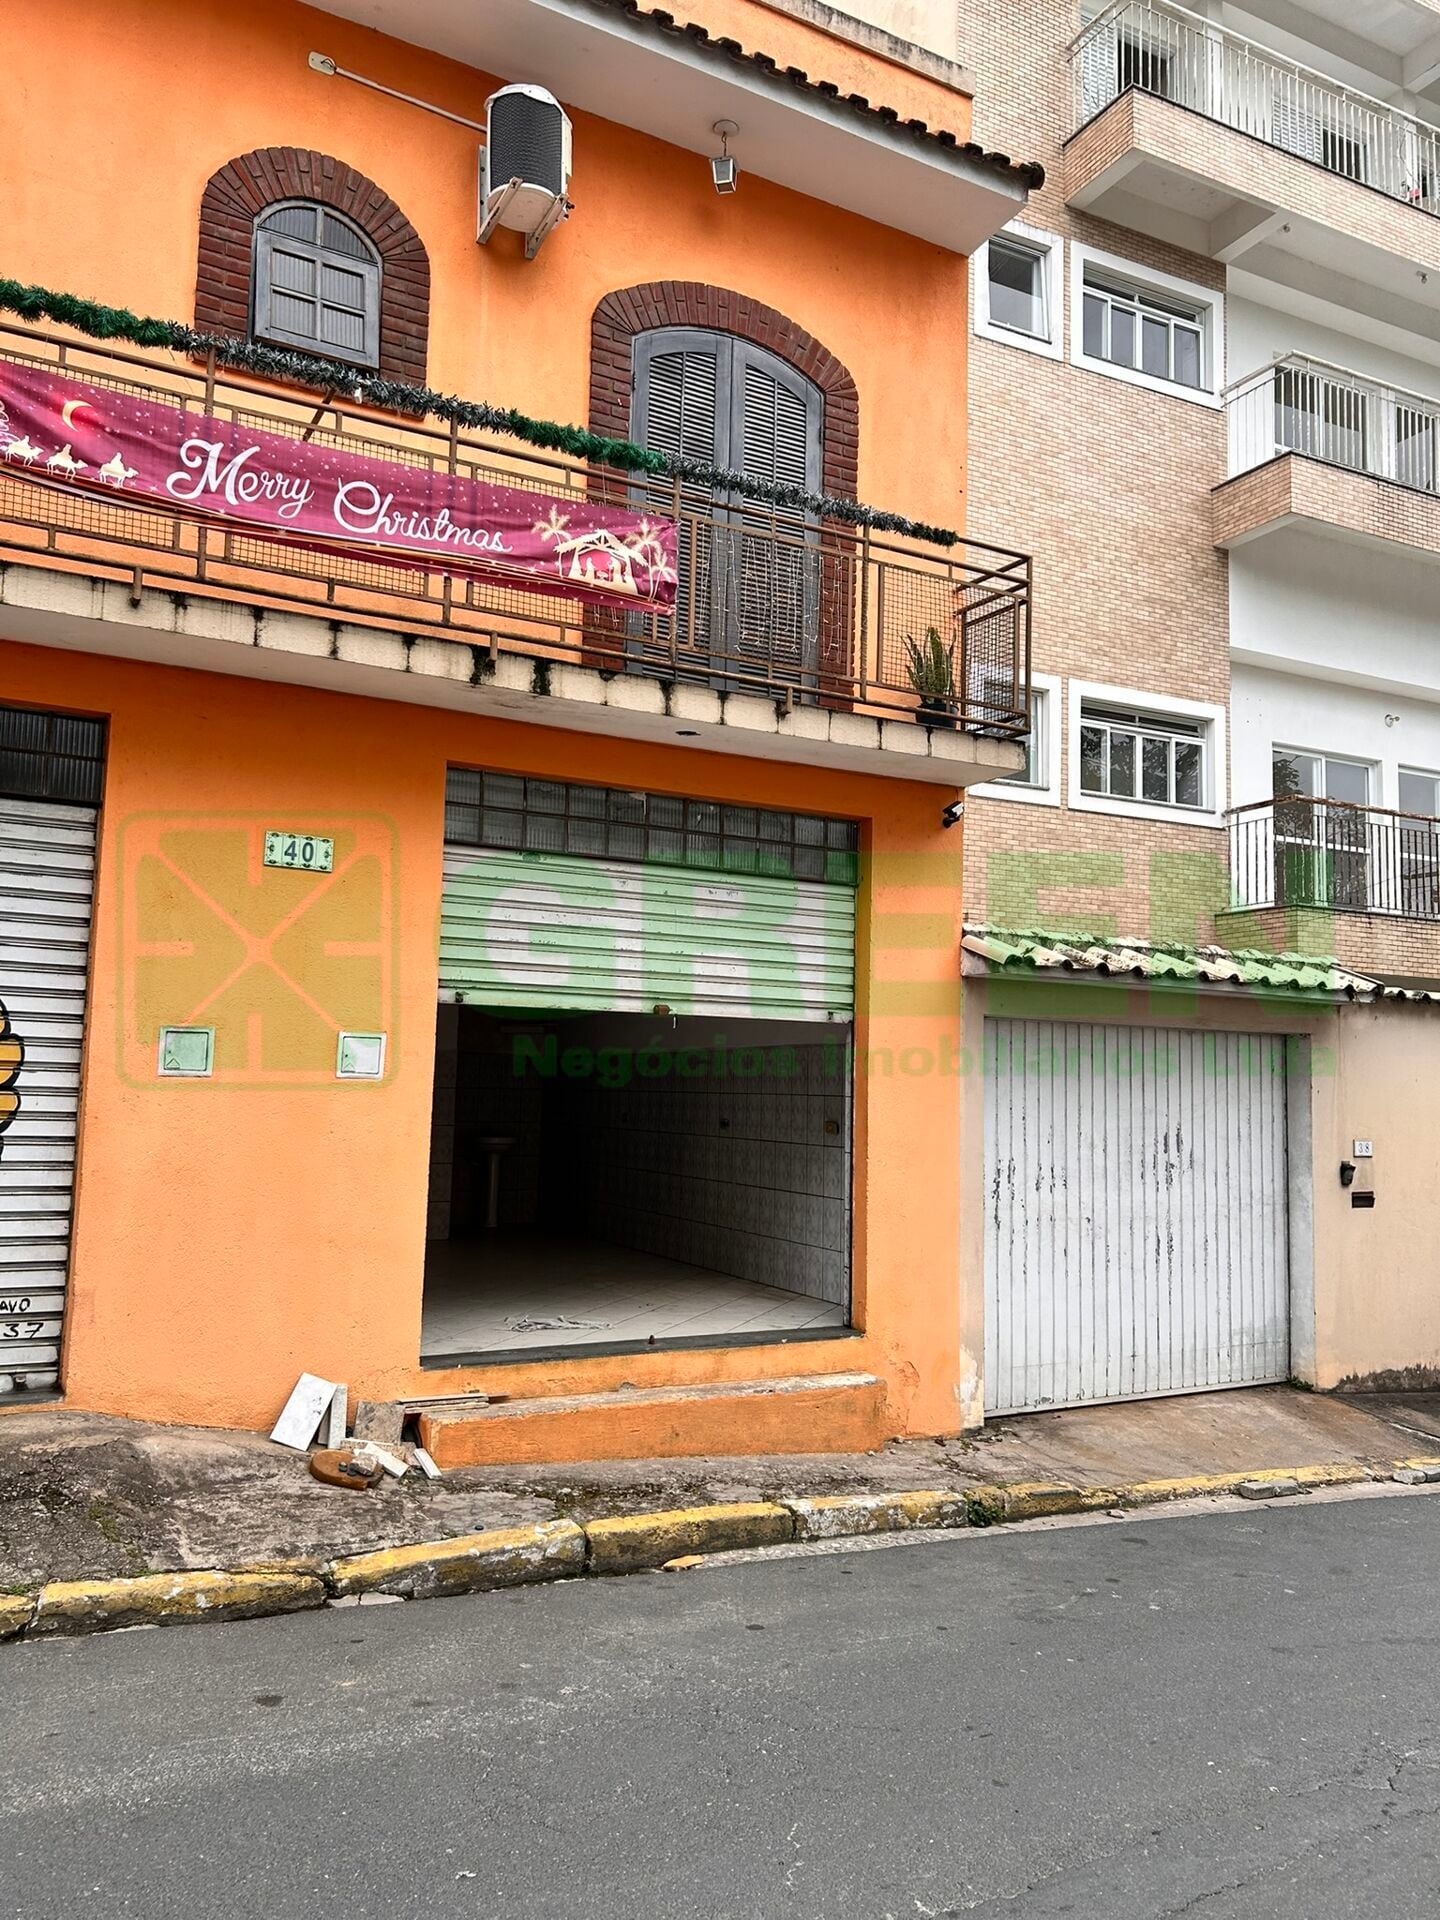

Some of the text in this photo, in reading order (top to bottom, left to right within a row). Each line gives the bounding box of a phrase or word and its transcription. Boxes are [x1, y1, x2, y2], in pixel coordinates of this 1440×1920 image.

[165, 438, 513, 553] Merry Christmas
[284, 840, 314, 862] 40
[1358, 1142, 1370, 1153] 38
